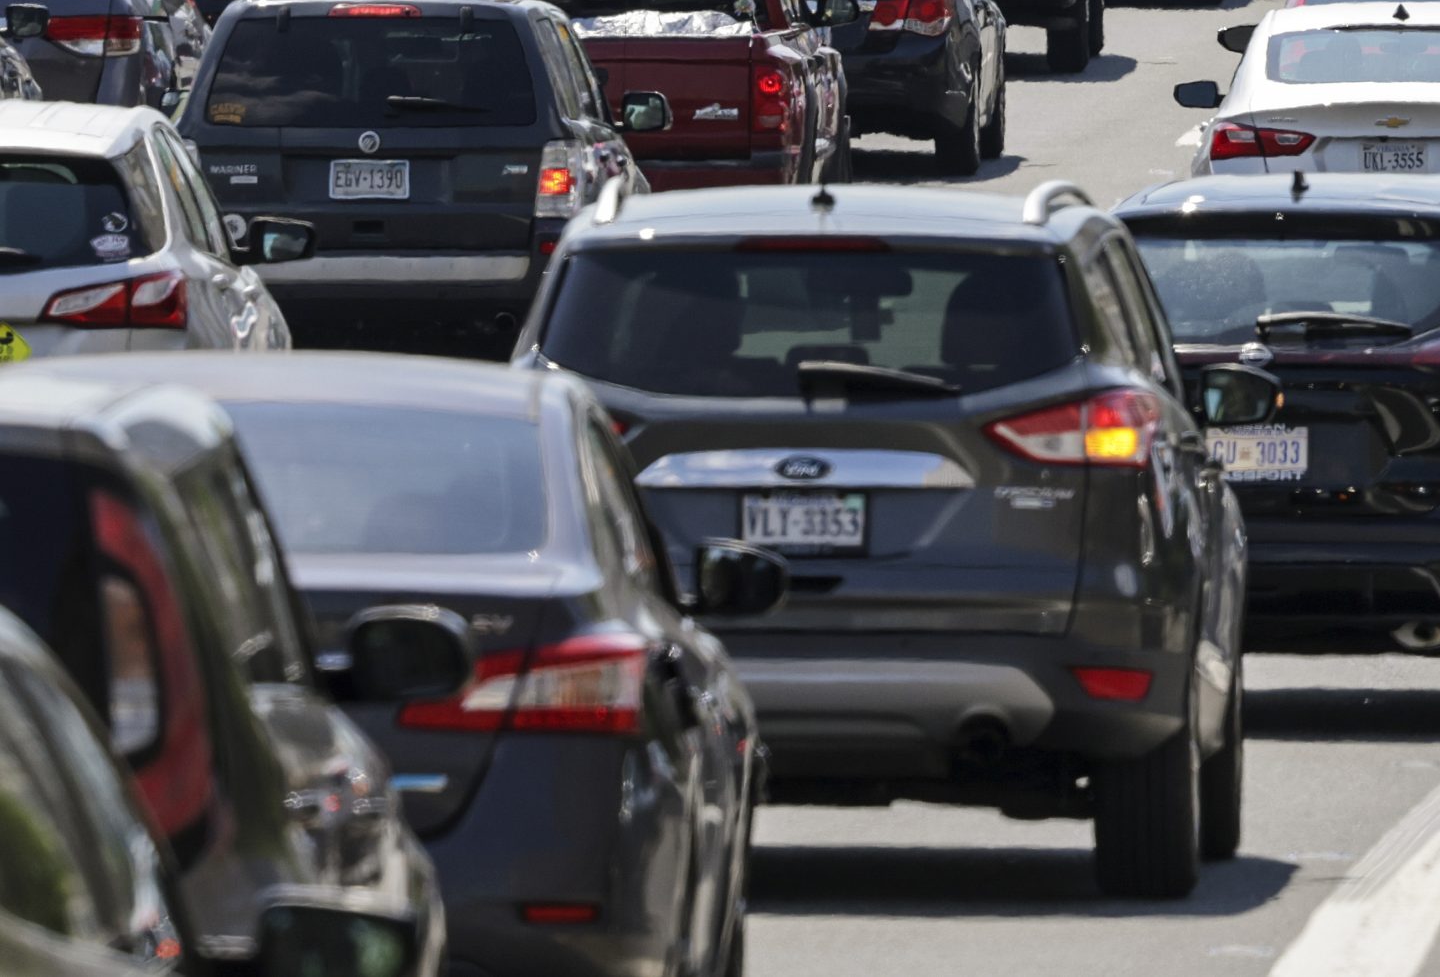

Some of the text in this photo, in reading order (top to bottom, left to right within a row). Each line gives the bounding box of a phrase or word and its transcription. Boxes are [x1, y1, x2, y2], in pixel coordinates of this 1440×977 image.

[210, 164, 258, 174] MARINER
[334, 167, 404, 190] EGV-1390
[1255, 439, 1301, 466] 3033
